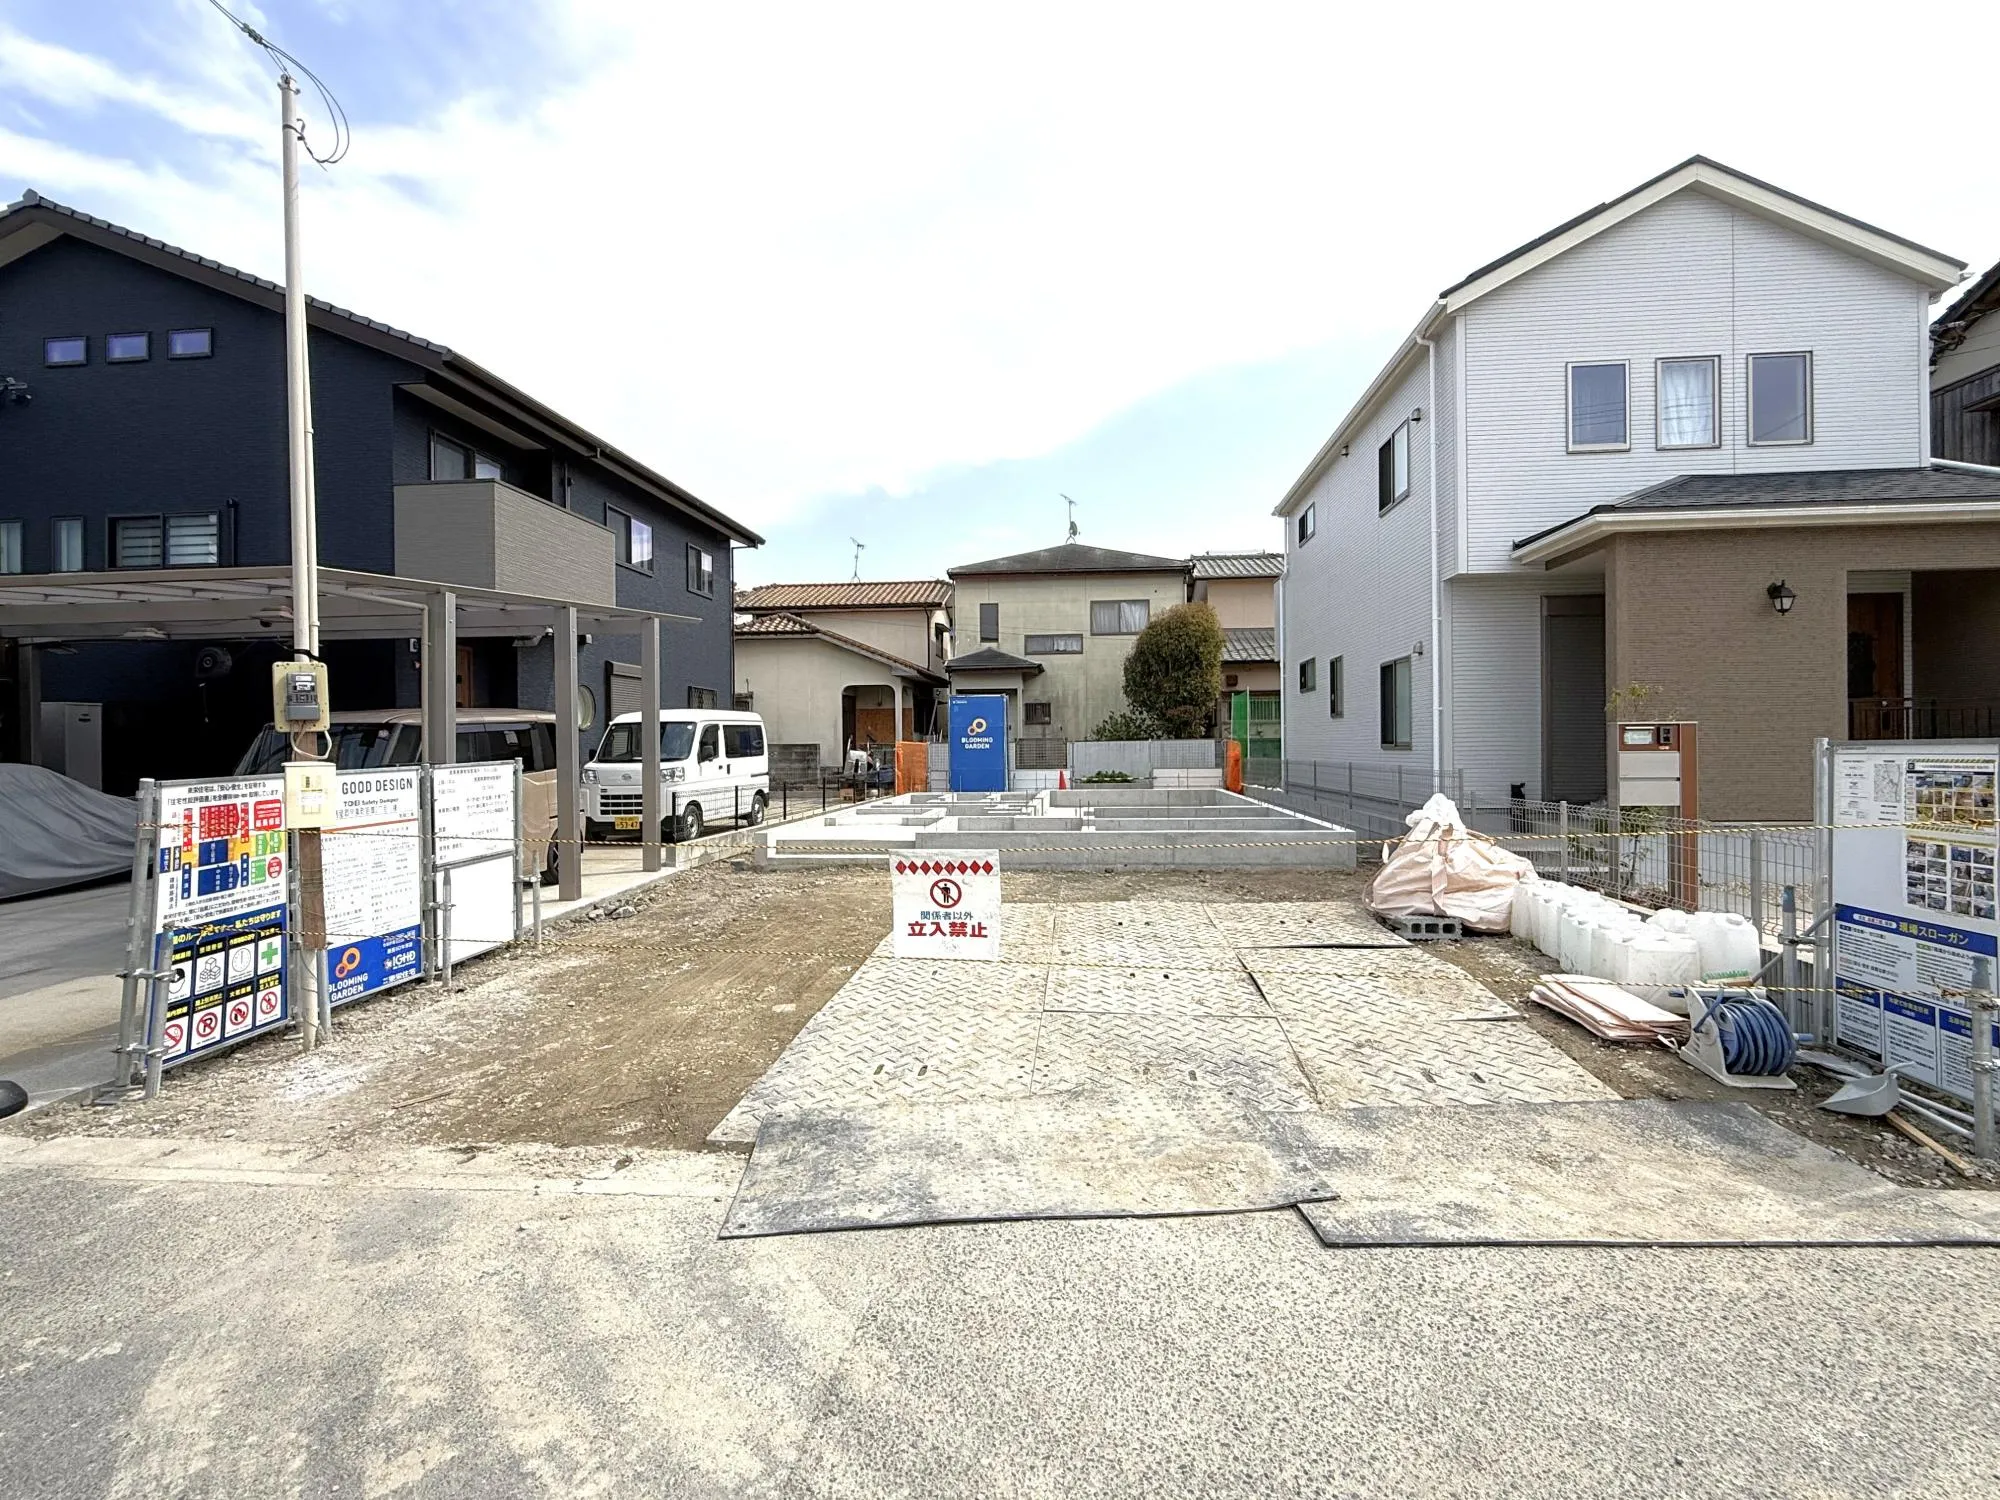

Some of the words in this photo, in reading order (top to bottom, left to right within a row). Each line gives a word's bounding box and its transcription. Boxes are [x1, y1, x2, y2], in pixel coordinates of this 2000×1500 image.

[342, 780, 371, 795] GOOD
[375, 778, 413, 792] DESIGN
[920, 911, 974, 921] 関係者以外
[907, 921, 988, 938] 立入禁止
[1899, 921, 1969, 945] 現場スローガン
[331, 983, 364, 1001] GARDEN
